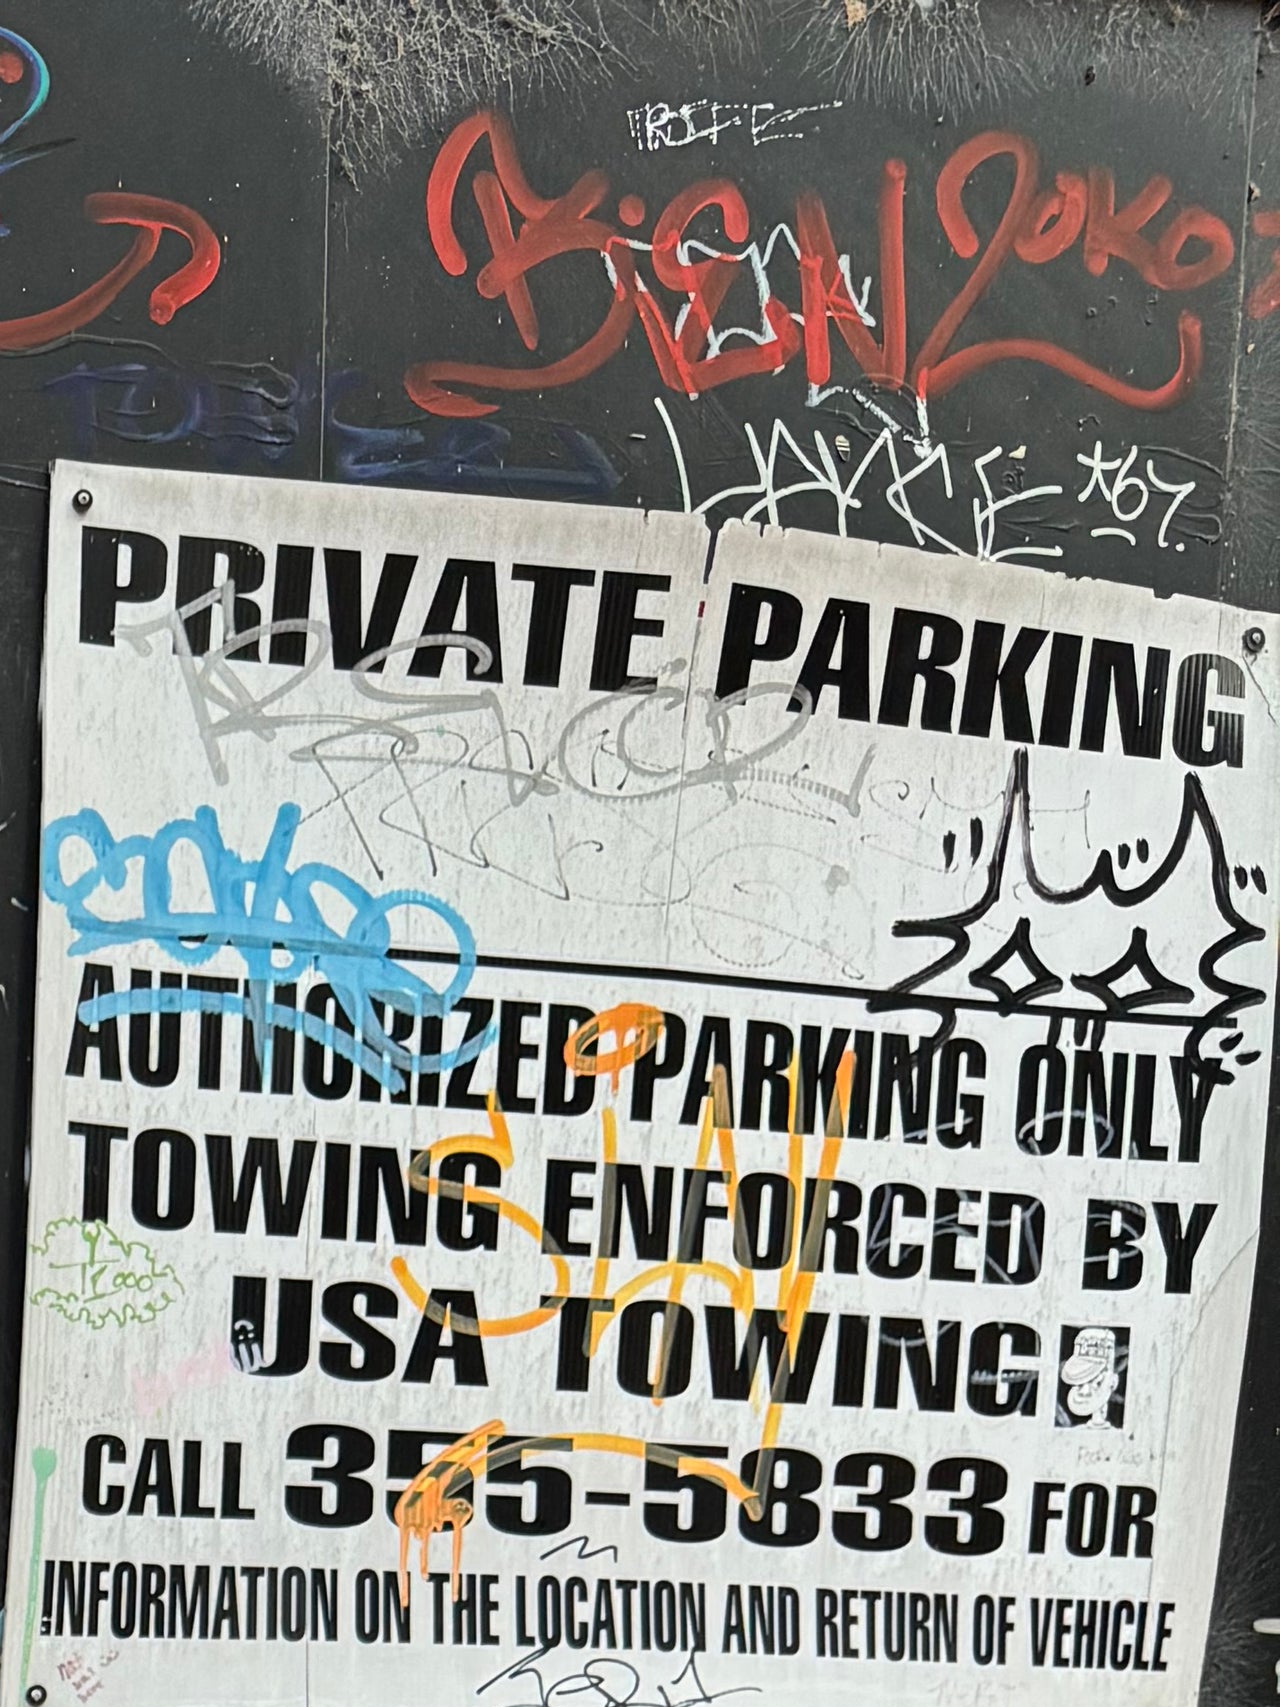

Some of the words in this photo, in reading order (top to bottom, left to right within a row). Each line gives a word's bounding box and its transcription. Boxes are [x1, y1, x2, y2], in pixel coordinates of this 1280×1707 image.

[77, 524, 672, 693] PRIVATE
[711, 581, 1245, 770] PARKING
[65, 962, 605, 1117] AUTHORIZED
[630, 1010, 987, 1148] PARKING
[1015, 1042, 1224, 1164] ONLY
[68, 1119, 502, 1252] TOWING
[540, 1157, 1045, 1287] ENFORCED
[1080, 1198, 1219, 1295] BY
[231, 1275, 490, 1388] USA
[540, 1293, 1042, 1418] TOWING
[81, 1433, 256, 1521] CALL
[285, 1422, 1008, 1557] 355-5833
[1028, 1480, 1158, 1559] FOR
[40, 1559, 339, 1643] INFORMATION
[355, 1567, 411, 1645] ON
[427, 1572, 500, 1646] THE
[515, 1574, 707, 1652] LOCATION
[721, 1584, 800, 1656] AND
[815, 1587, 959, 1664] RETURN
[972, 1594, 1017, 1666] OF
[1030, 1596, 1176, 1672] VEHICLE
